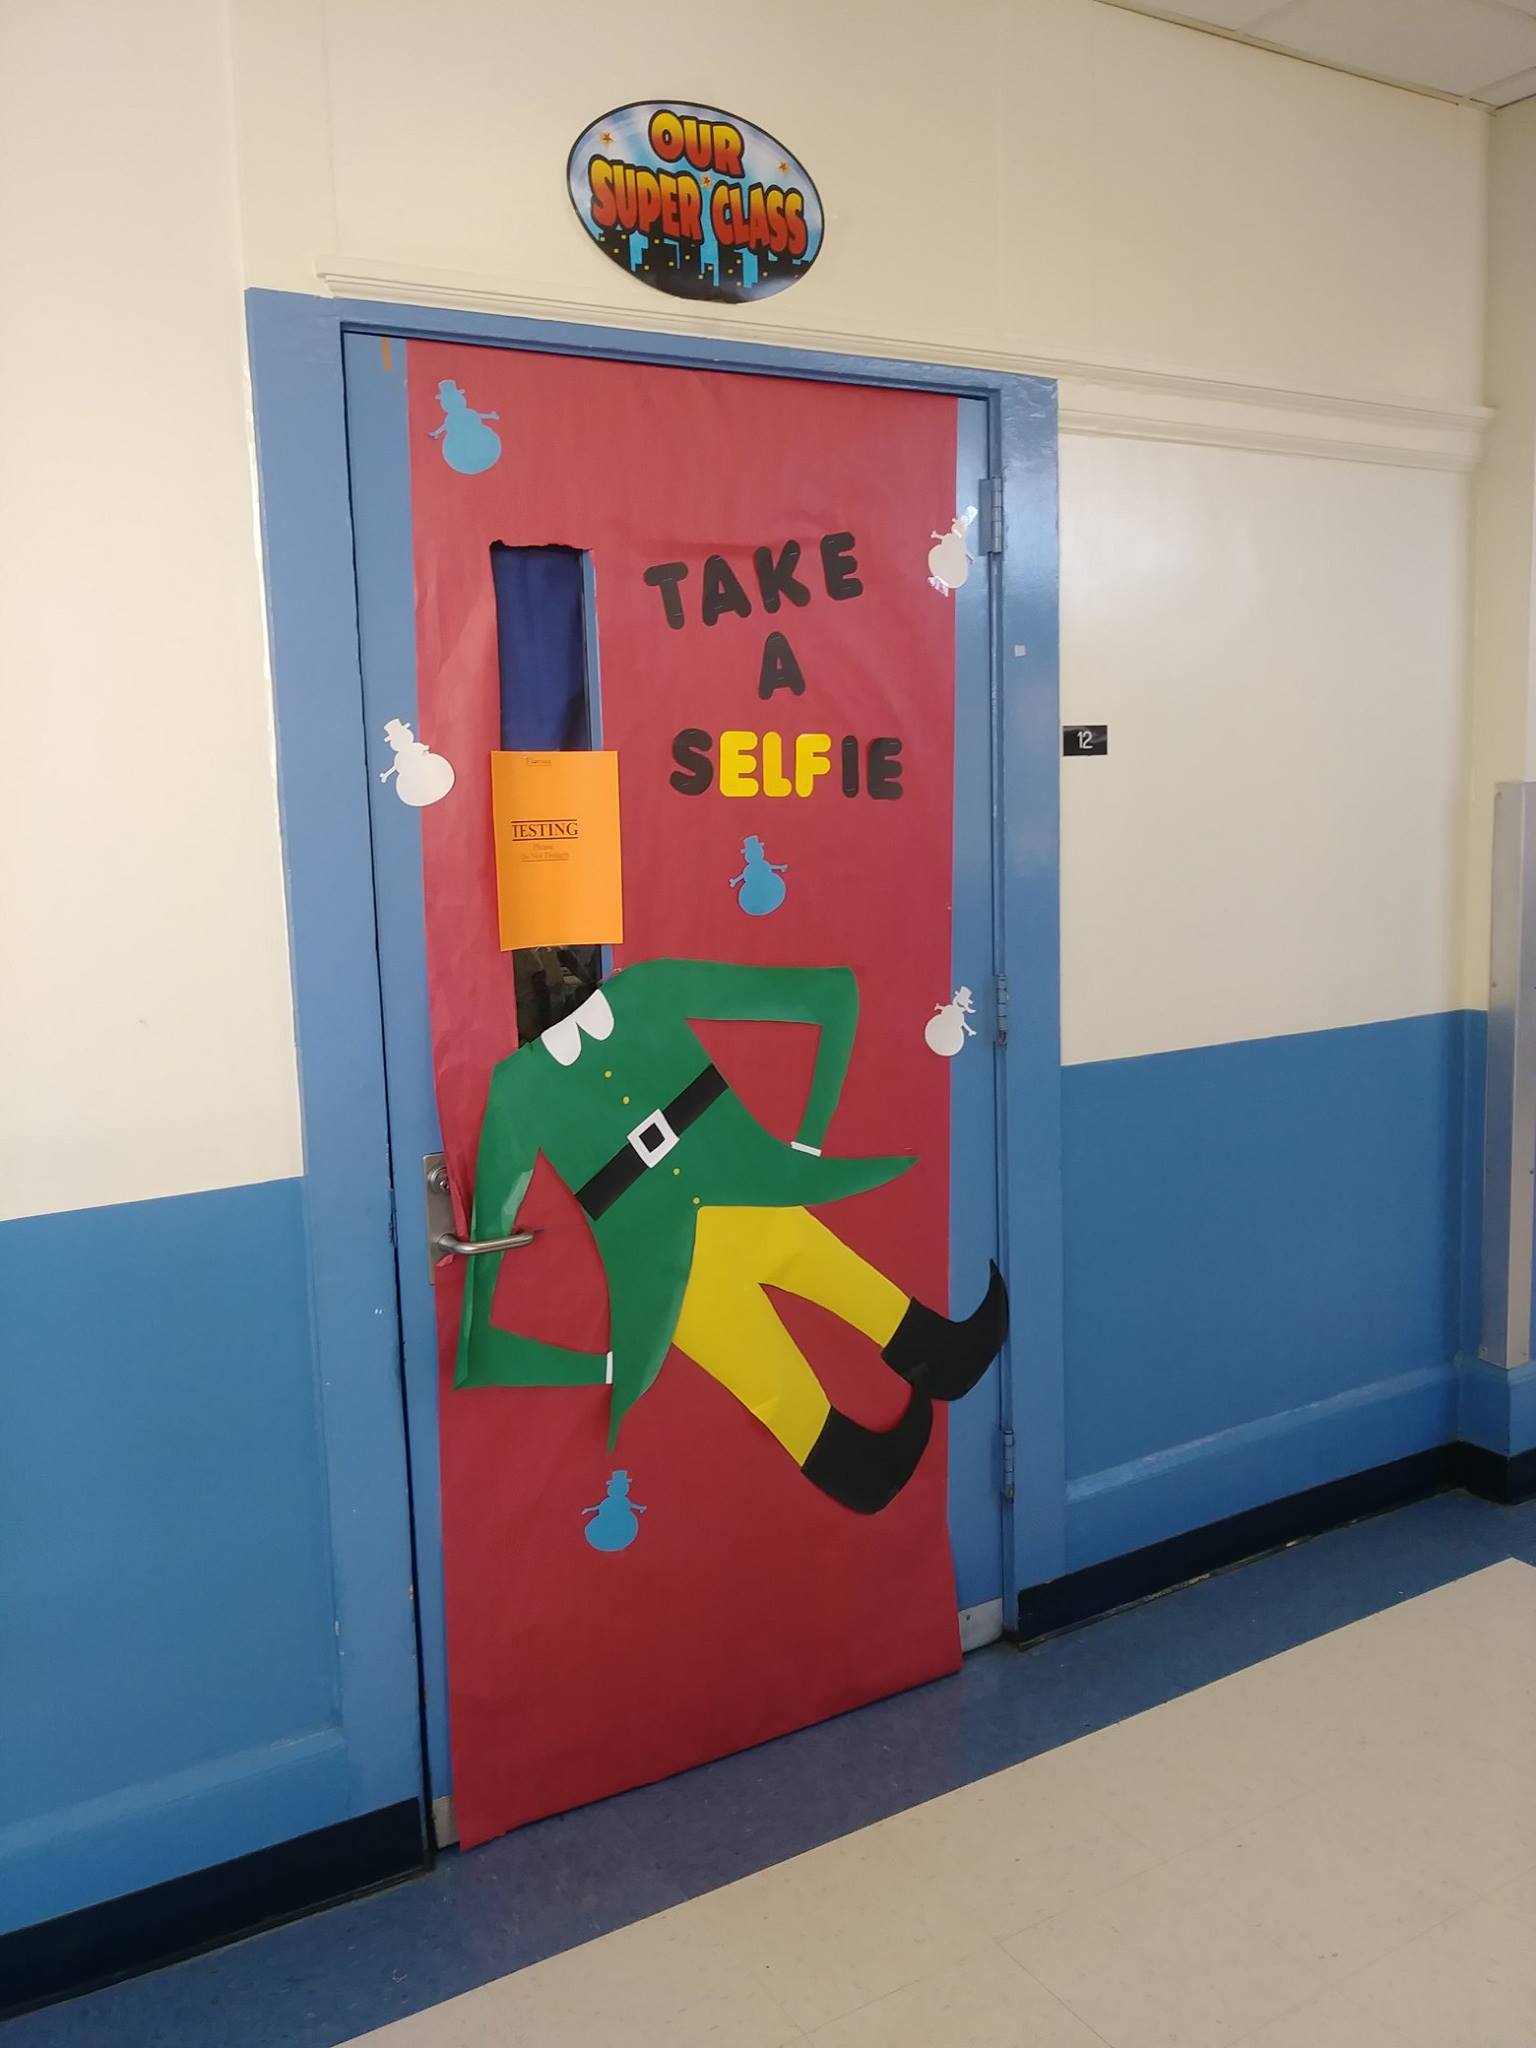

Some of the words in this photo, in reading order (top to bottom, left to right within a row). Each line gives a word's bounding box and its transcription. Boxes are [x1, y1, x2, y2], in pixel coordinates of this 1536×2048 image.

[648, 109, 745, 178] OUR
[588, 154, 704, 245] SUPER
[711, 182, 808, 258] CLASS
[643, 532, 863, 630] TAKE
[758, 631, 806, 700] A
[670, 728, 903, 800] SELFIE
[1077, 730, 1093, 749] 12
[512, 822, 578, 838] TESTING
